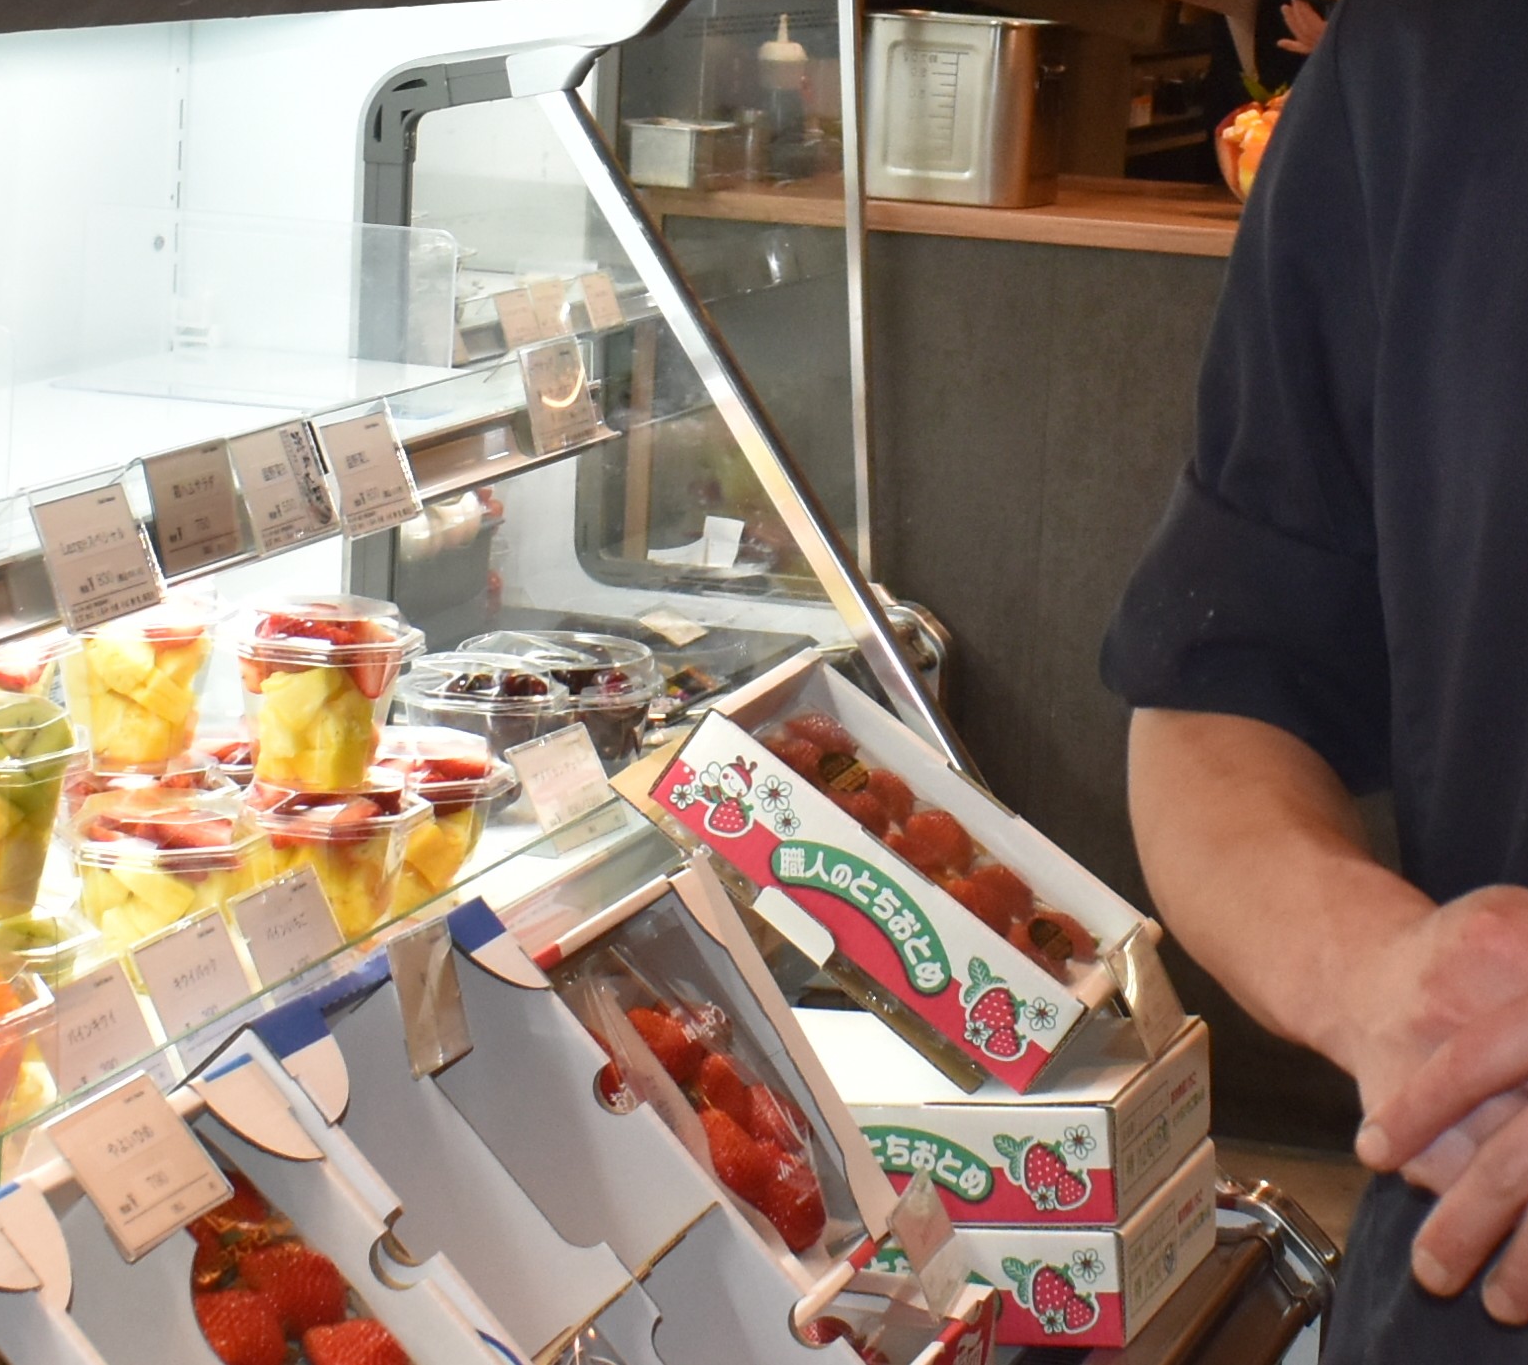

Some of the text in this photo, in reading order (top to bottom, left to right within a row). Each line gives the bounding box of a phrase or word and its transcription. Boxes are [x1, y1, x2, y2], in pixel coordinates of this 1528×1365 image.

[777, 845, 946, 989] 職人のとちおとめ
